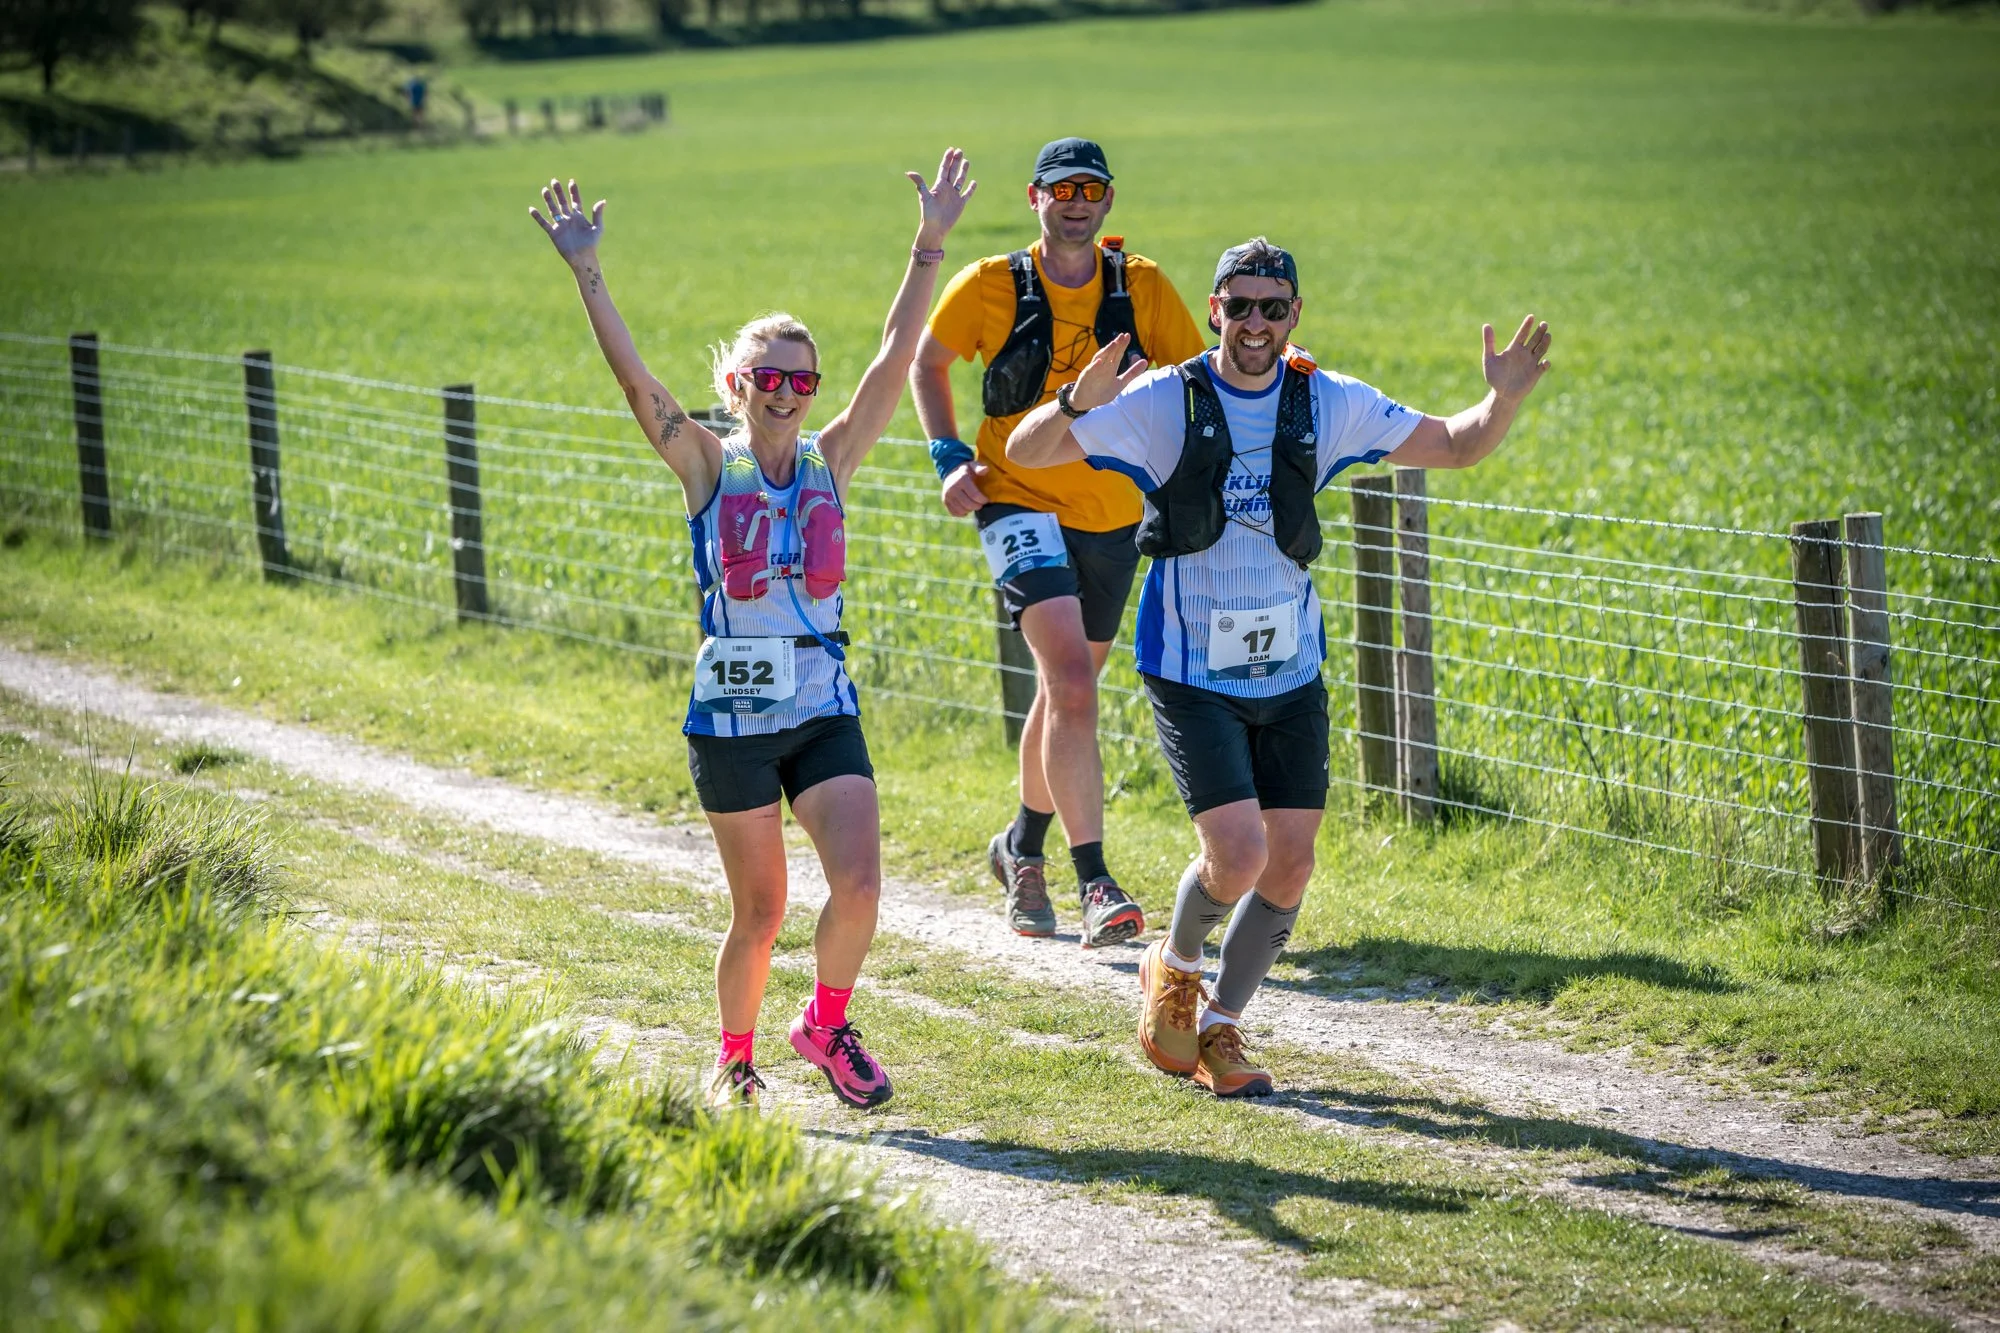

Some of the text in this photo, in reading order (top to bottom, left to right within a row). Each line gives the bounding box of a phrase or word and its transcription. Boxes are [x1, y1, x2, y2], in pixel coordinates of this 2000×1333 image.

[1002, 528, 1039, 557] 23
[1007, 548, 1042, 564] BENJAMIN
[1242, 627, 1276, 654] 17
[1247, 654, 1270, 663] ADAM
[710, 660, 775, 685] 152
